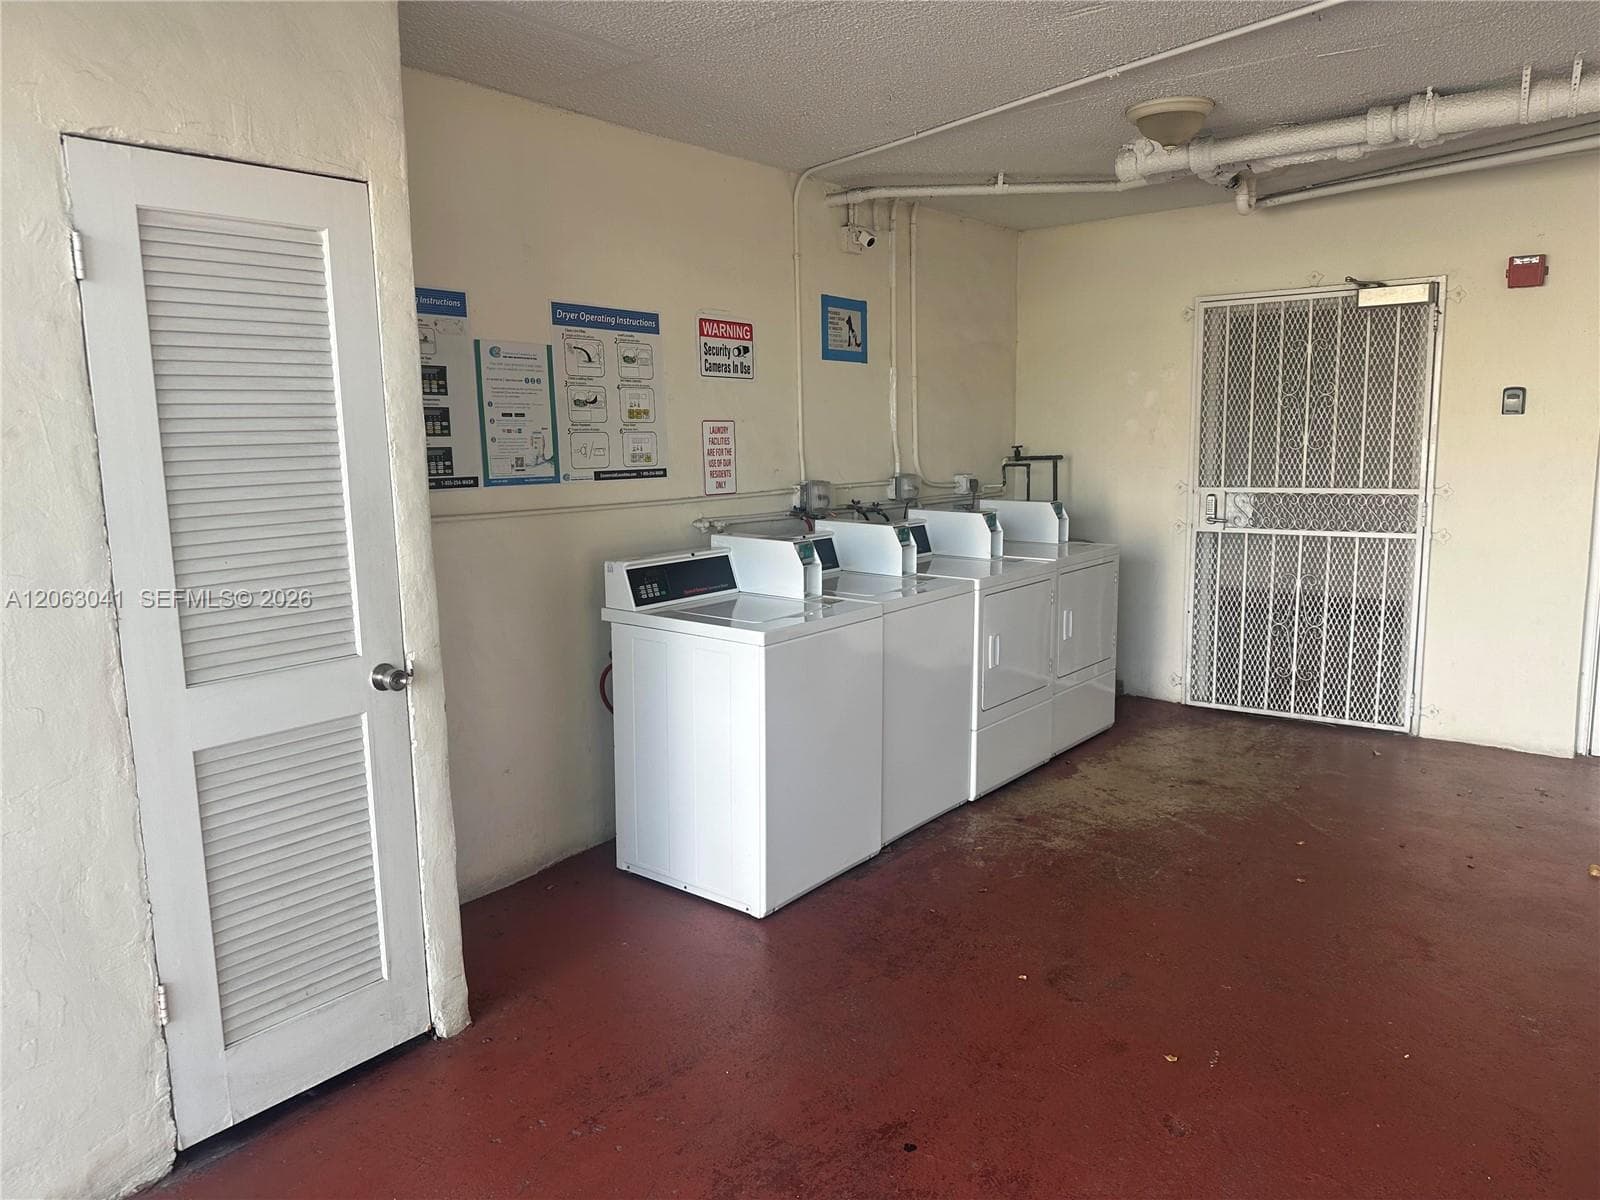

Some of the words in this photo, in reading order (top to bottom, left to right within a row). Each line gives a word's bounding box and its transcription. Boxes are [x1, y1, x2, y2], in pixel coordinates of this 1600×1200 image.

[419, 296, 461, 307] Instructions
[556, 309, 579, 321] Dryer
[579, 311, 616, 326] Operating
[616, 316, 656, 328] Instructions
[702, 321, 751, 339] WARNING
[703, 342, 731, 360] Security
[704, 358, 731, 374] Cameras
[732, 360, 739, 374] In
[740, 361, 751, 375] Use
[709, 426, 728, 434] LAUNDRY
[708, 437, 730, 445] FACILITIES
[707, 448, 715, 456] ARE
[715, 448, 724, 456] FOR
[724, 448, 732, 456] THE
[708, 459, 716, 467] USE
[717, 459, 722, 467] OF
[723, 459, 731, 467] OUR
[709, 470, 731, 478] RESIDENTS
[715, 481, 726, 489] ONLY
